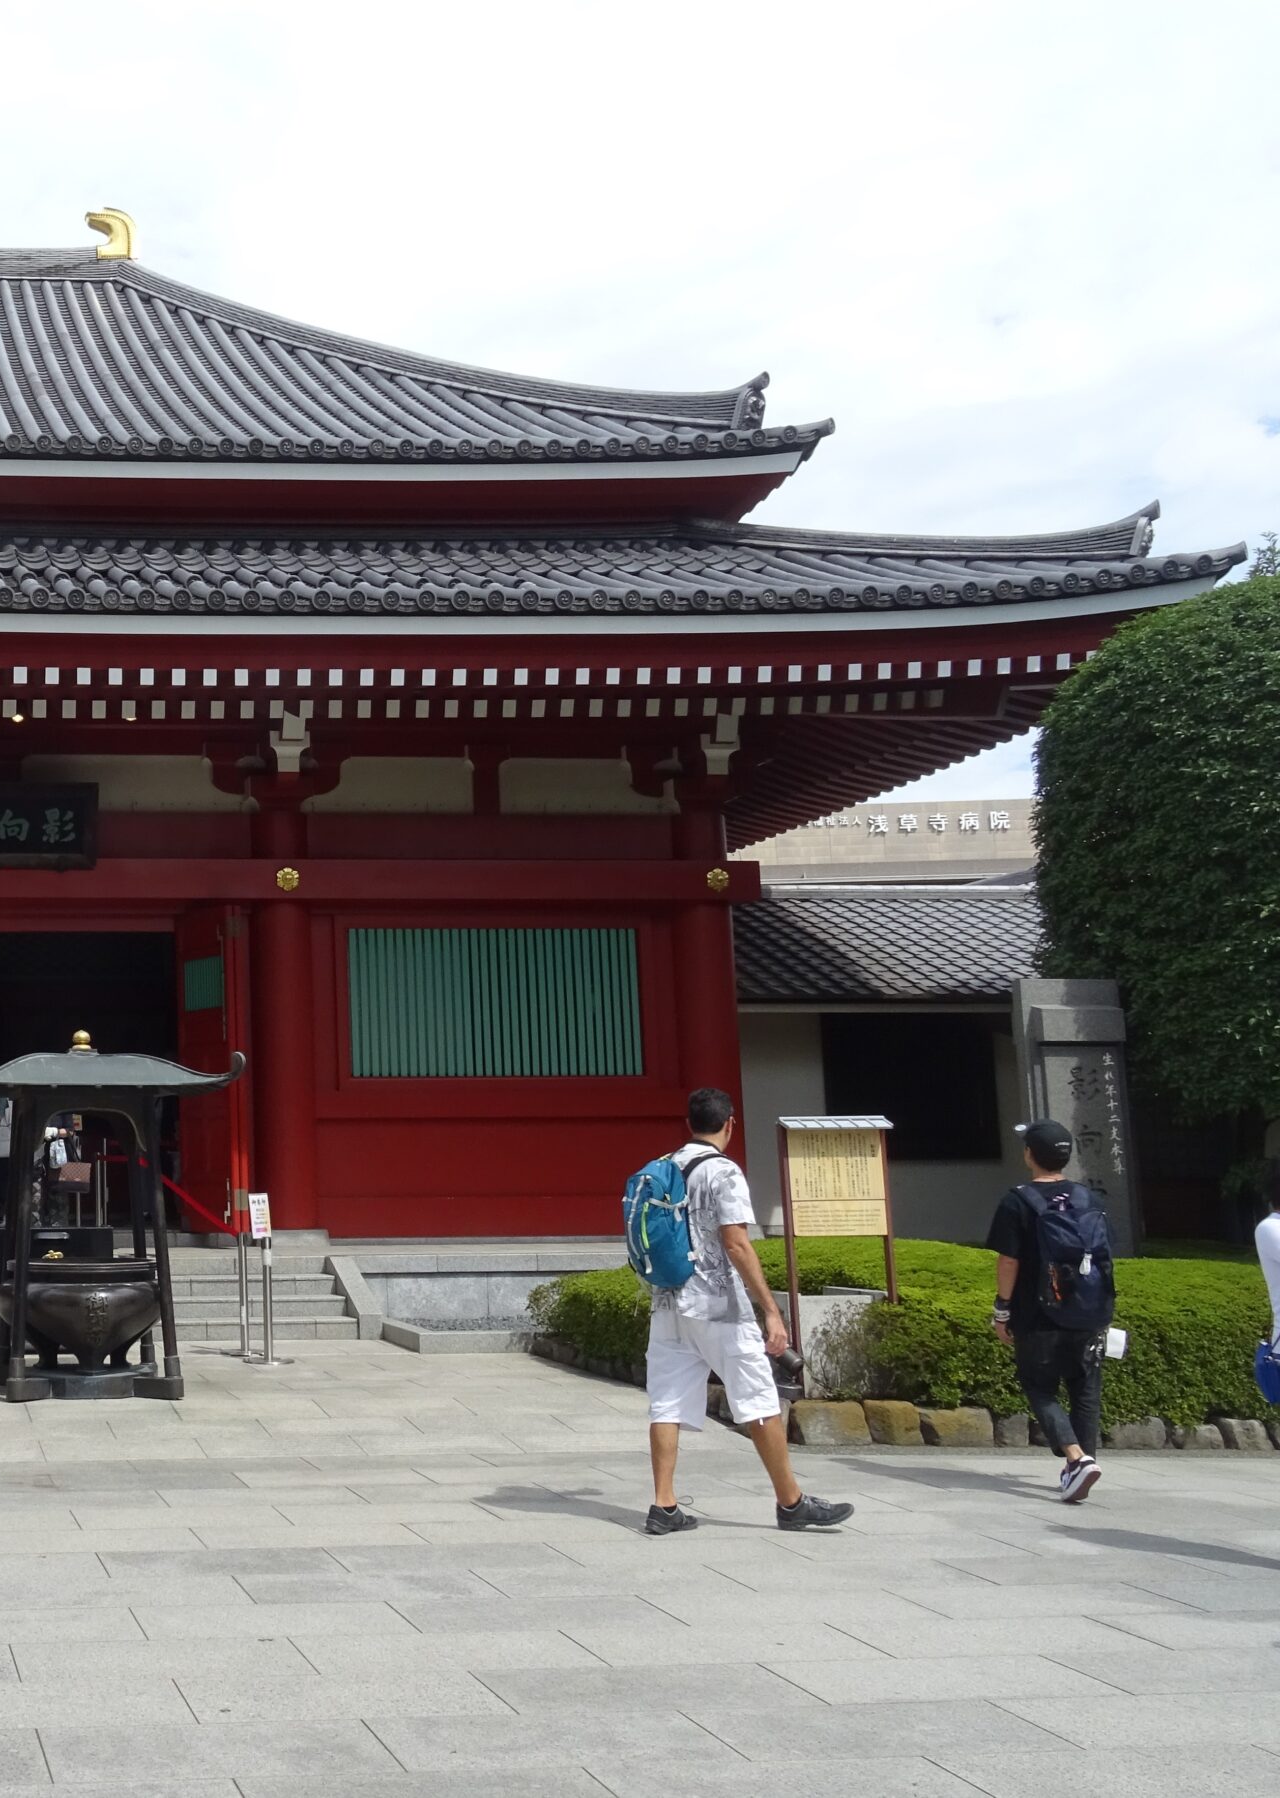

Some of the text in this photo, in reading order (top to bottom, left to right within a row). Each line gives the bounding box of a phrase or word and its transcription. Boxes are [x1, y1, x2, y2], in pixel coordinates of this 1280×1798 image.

[807, 815, 862, 827] 福祉法人
[868, 810, 1011, 832] 浅草寺病院
